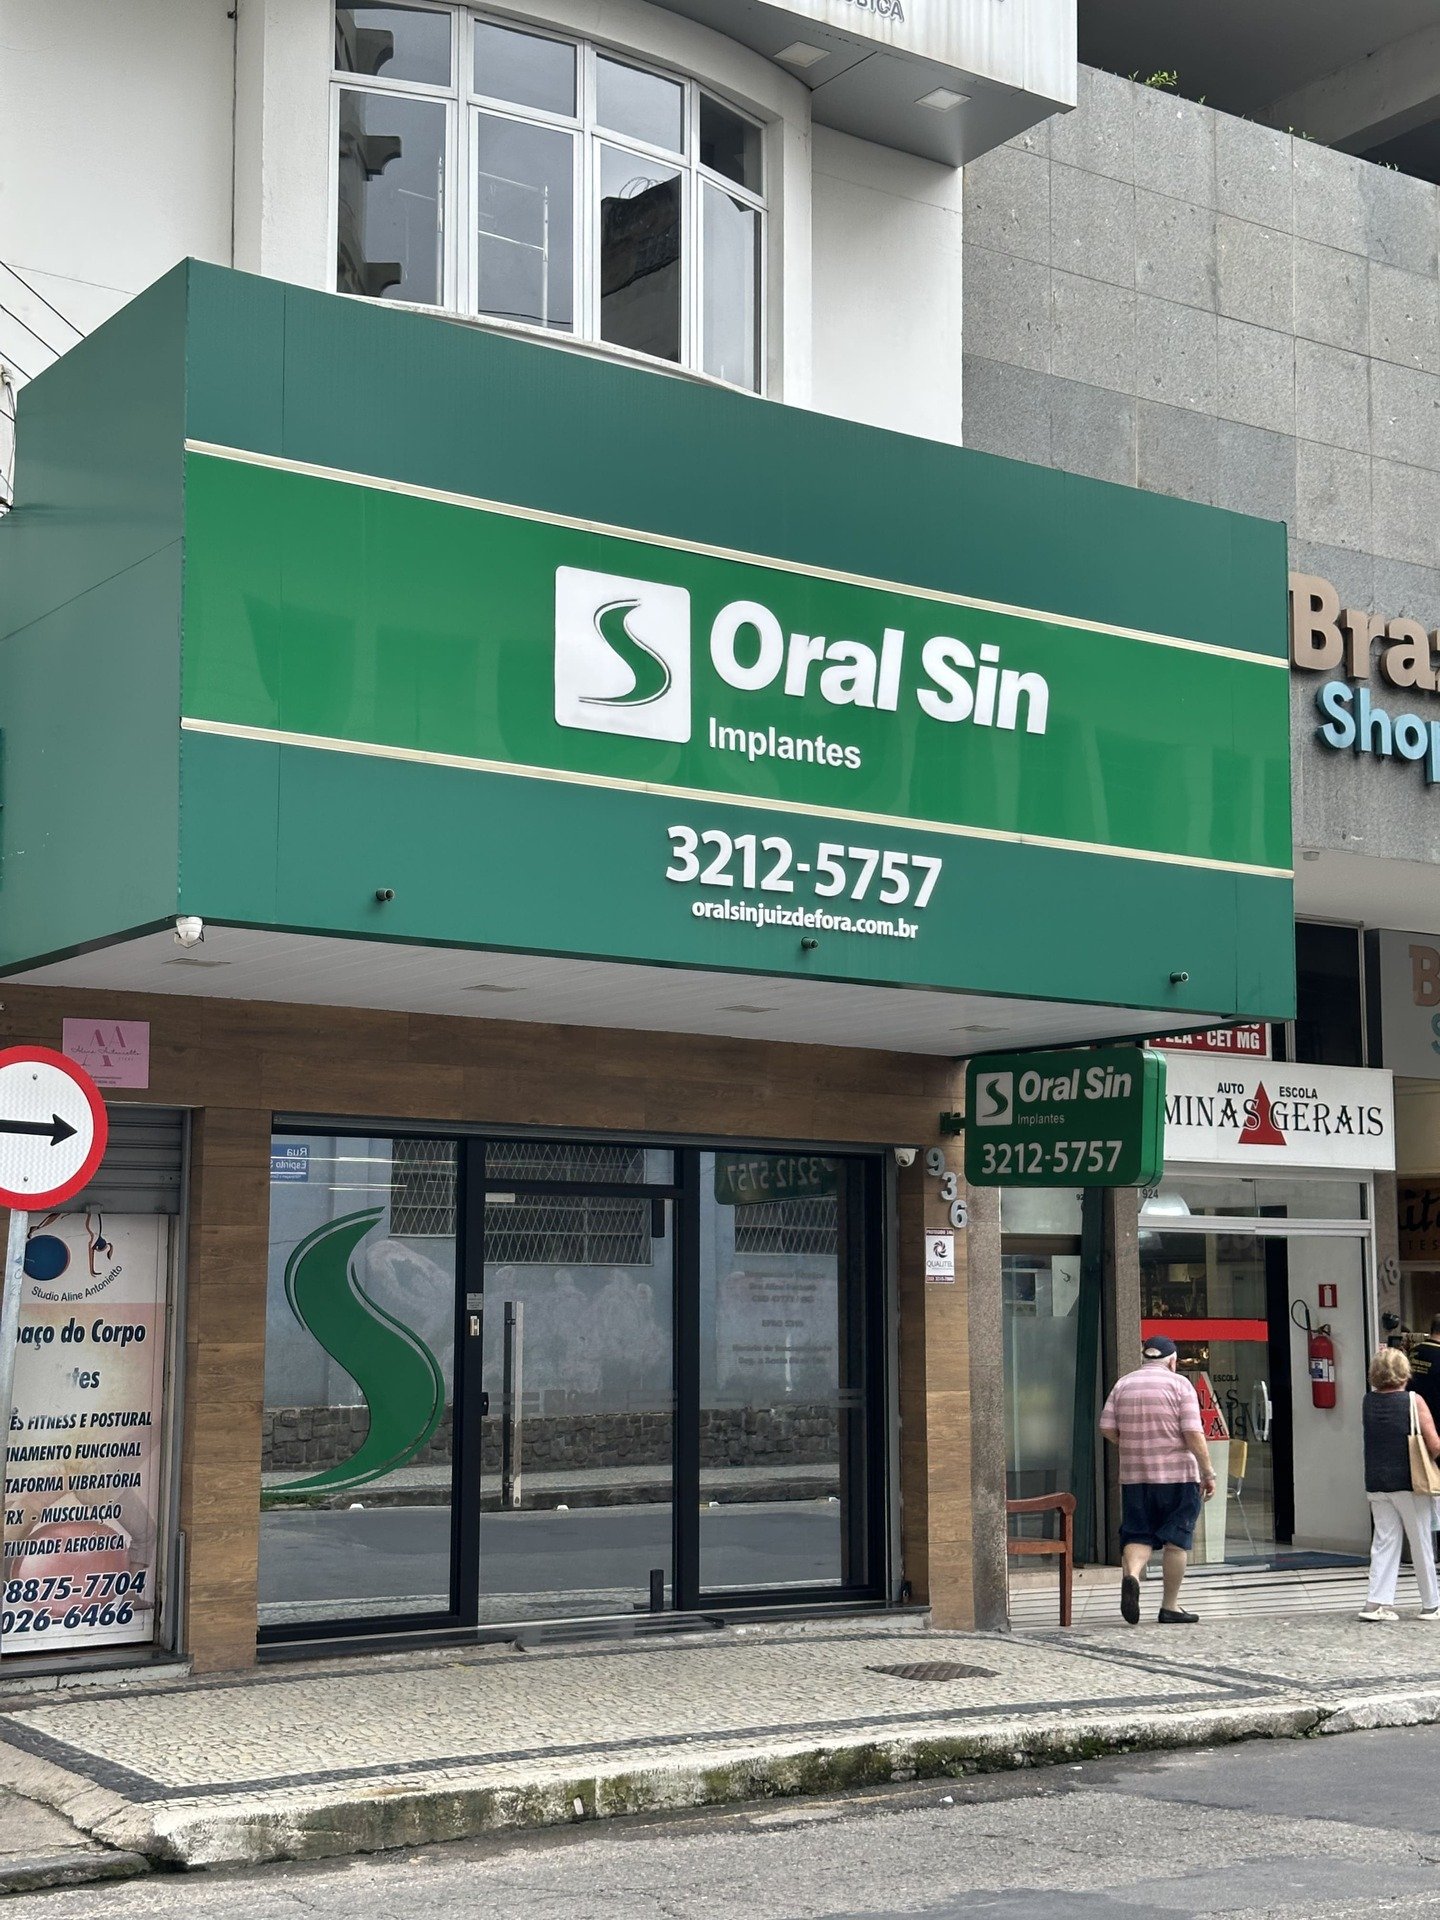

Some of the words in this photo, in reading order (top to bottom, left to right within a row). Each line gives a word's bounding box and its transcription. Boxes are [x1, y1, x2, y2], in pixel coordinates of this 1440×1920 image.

[1289, 571, 1440, 691] Bra
[709, 600, 905, 712] Oral
[917, 635, 1050, 735] Sin
[709, 717, 861, 770] Implantes
[665, 825, 943, 908] 3212-5757
[692, 899, 919, 939] oralsinjuizdefora.com.br
[1206, 1030, 1233, 1047] CET
[1237, 1031, 1260, 1049] MG
[1018, 1068, 1080, 1103] Oral
[1084, 1066, 1132, 1100] Sin
[1217, 1081, 1245, 1095] AUTO
[1279, 1086, 1318, 1099] ESCOLA
[1018, 1113, 1065, 1127] Implantes
[1164, 1094, 1260, 1129] MINAS
[1270, 1101, 1384, 1137] GERAIS
[981, 1140, 1123, 1174] 3212-5757
[1142, 1188, 1159, 1199] 924
[31, 1286, 59, 1301] Studio
[61, 1292, 83, 1301] Aline
[85, 1265, 122, 1297] Antonietto
[61, 1318, 85, 1344] do
[92, 1319, 146, 1347] Corpo
[1213, 1374, 1239, 1382] ESCOLA
[28, 1413, 77, 1430] FITNESS
[80, 1413, 87, 1428] E
[90, 1411, 152, 1427] POSTURAL
[75, 1442, 141, 1460] FUNCIONAL
[68, 1469, 141, 1490] VIBRATÓRIA
[41, 1500, 122, 1524] MUSCULAÇÃO
[64, 1532, 124, 1553] AERÓBICA
[3, 1570, 147, 1604] 8875-7704
